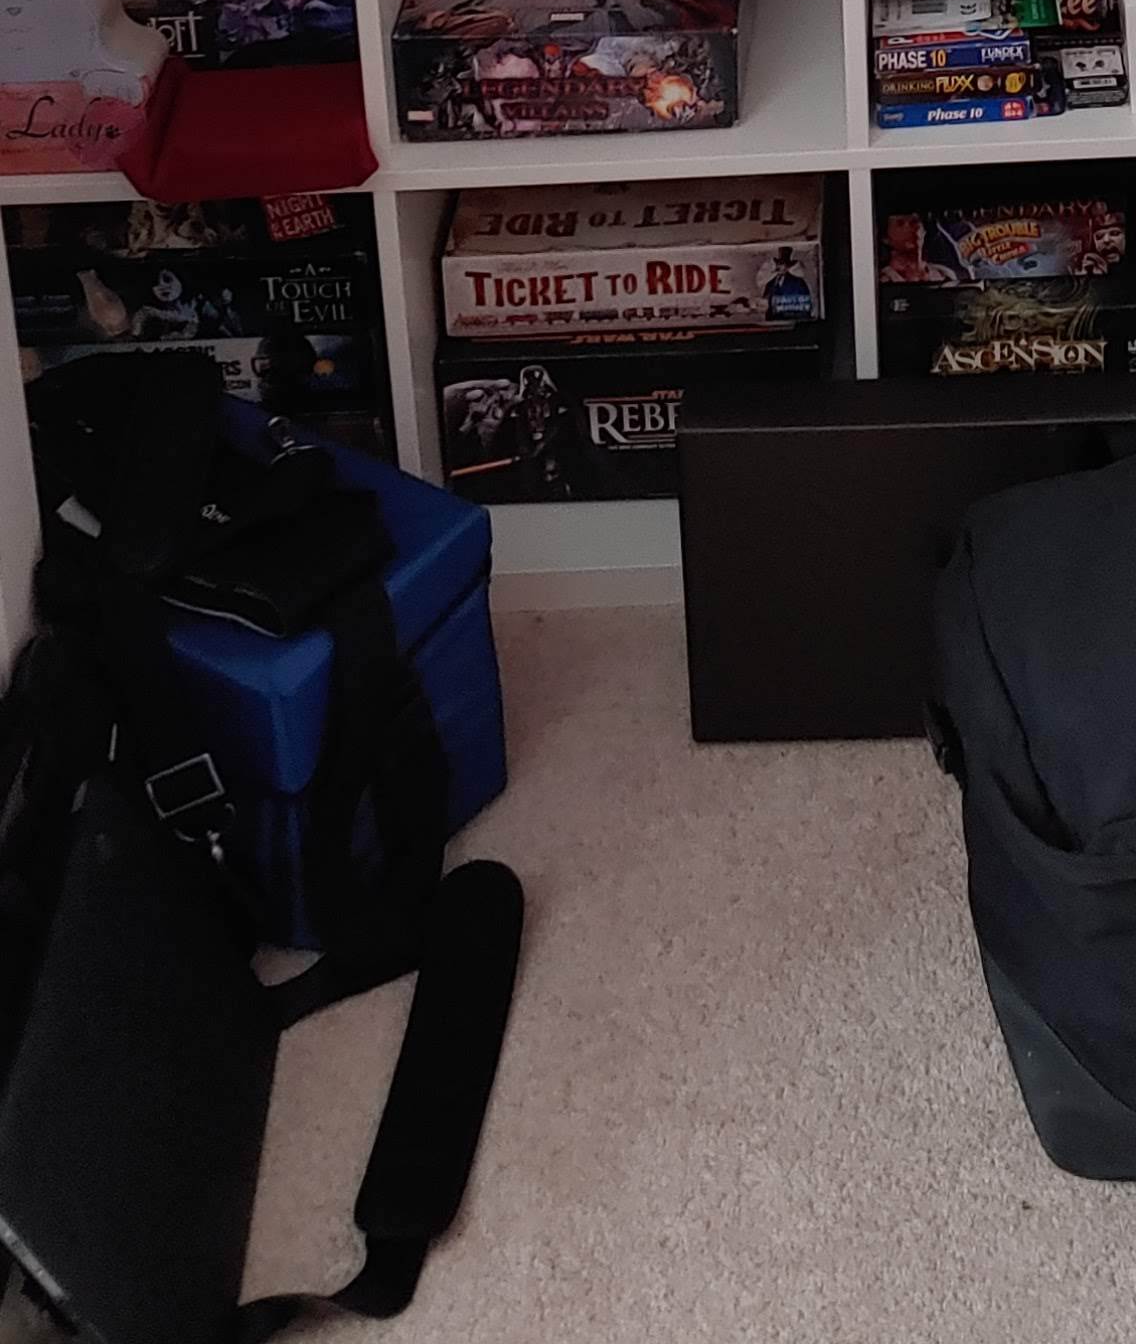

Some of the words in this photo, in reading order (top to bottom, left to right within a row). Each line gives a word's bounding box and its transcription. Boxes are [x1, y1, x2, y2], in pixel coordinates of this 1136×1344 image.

[877, 51, 928, 70] PHASE
[928, 49, 947, 68] 10
[927, 107, 966, 122] Phase
[967, 105, 984, 120] 10
[283, 210, 336, 237] EARTH
[473, 210, 579, 238] RIDE
[633, 198, 796, 230] TICKET
[982, 220, 1041, 244] TROUBLE
[259, 276, 352, 303] TOUCH
[464, 269, 599, 308] TICKET
[604, 274, 640, 297] TO
[646, 260, 733, 296] RIDE
[292, 299, 352, 324] EVIL
[931, 338, 1107, 374] ASCENSION
